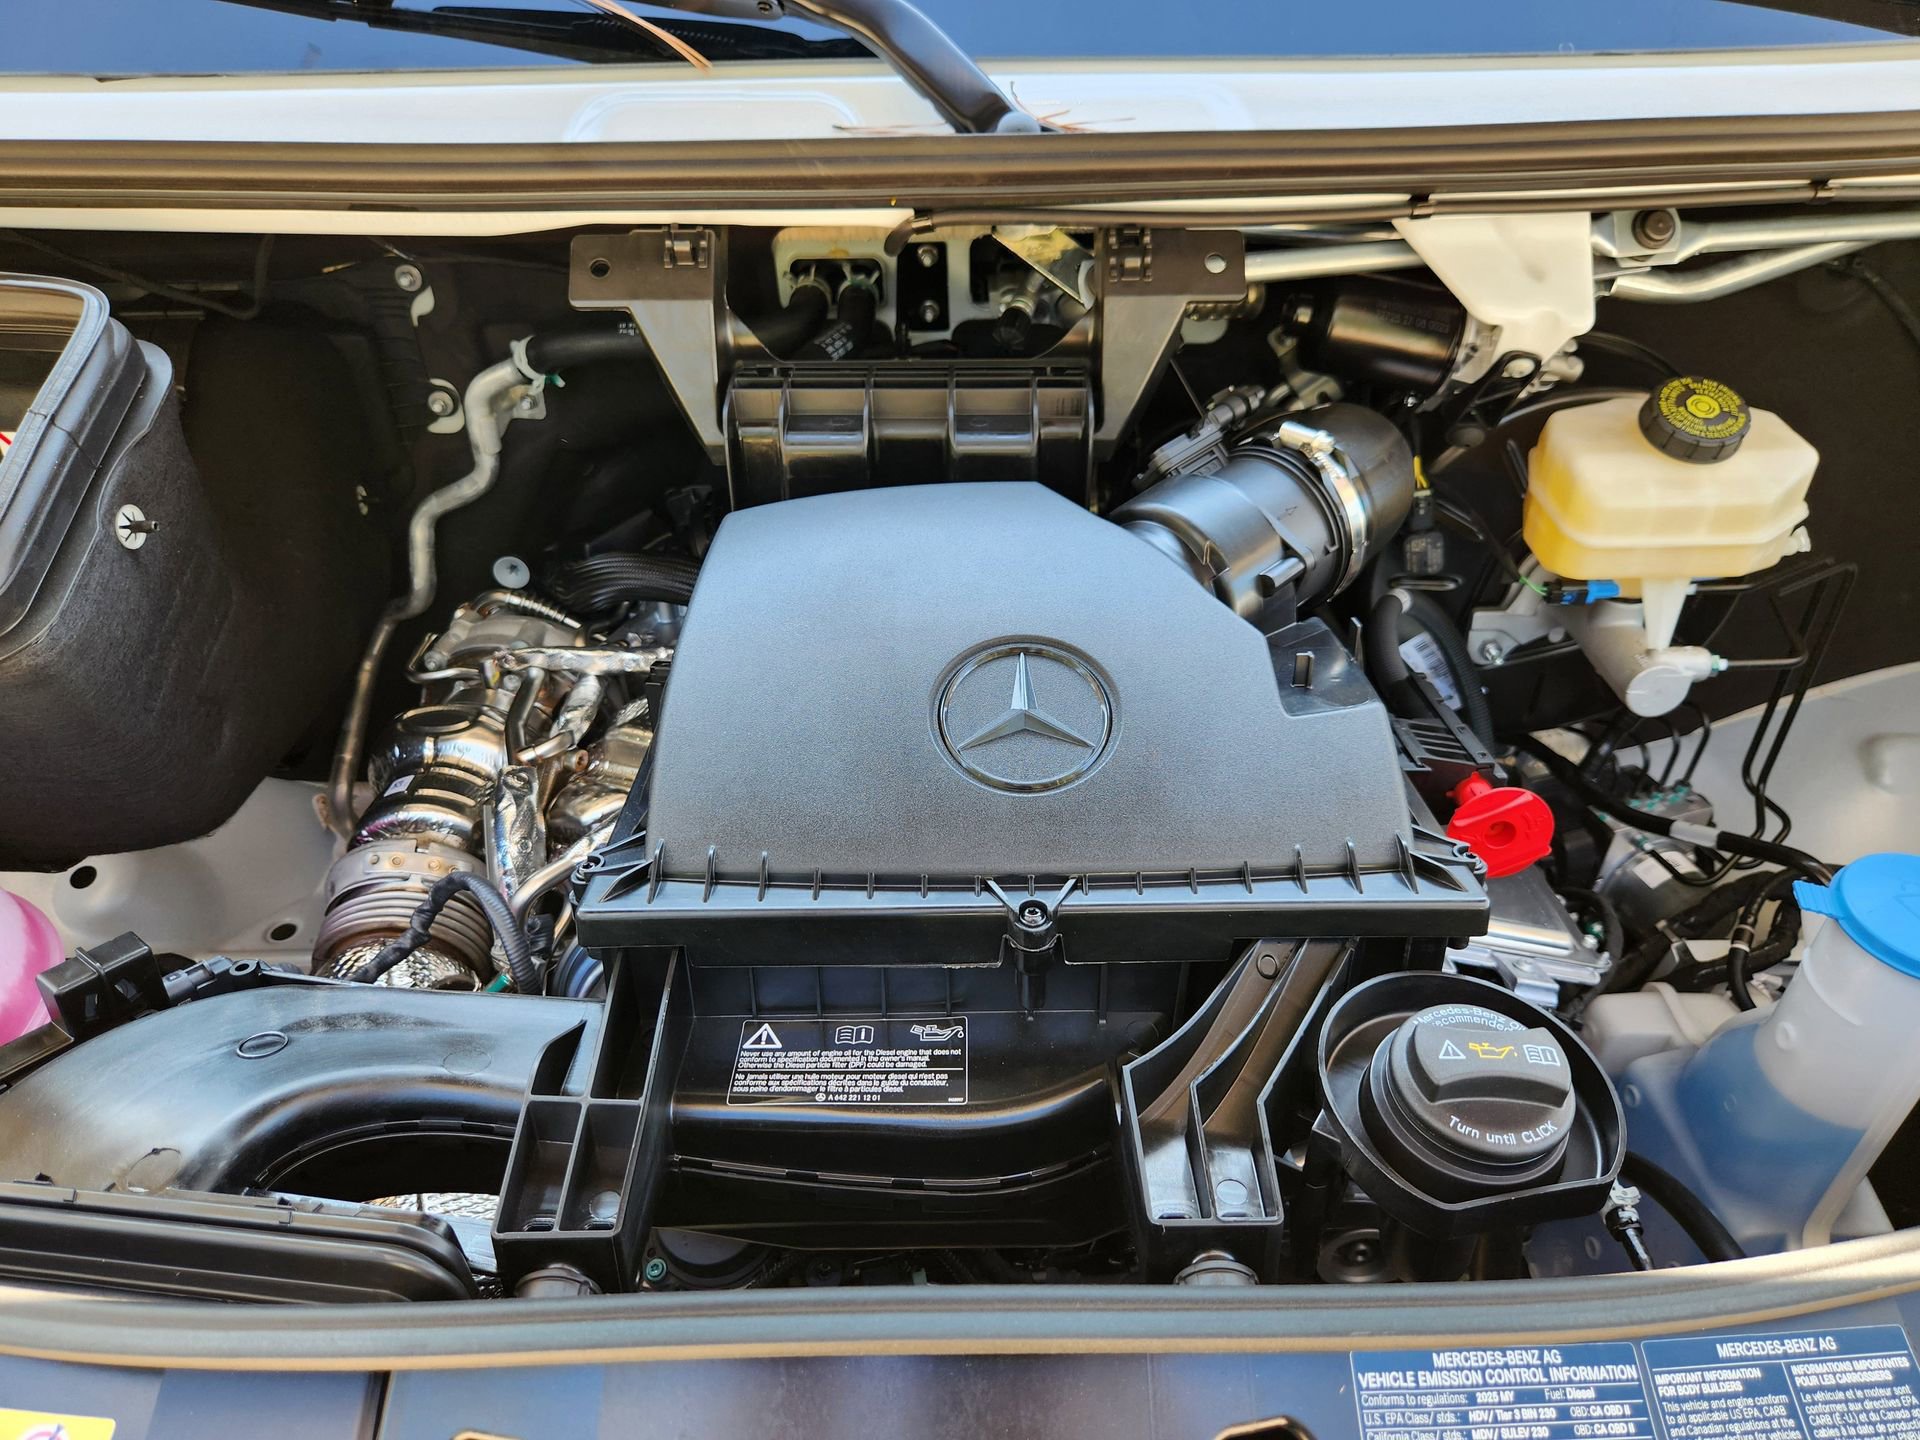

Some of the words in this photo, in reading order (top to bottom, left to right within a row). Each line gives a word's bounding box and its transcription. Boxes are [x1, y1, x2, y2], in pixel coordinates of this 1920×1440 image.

[1449, 1115, 1480, 1140] Turn
[1486, 1132, 1516, 1145] until
[1521, 1120, 1558, 1144] CLICK
[1716, 1338, 1817, 1358] MERCEDES-BENZ
[1818, 1336, 1837, 1351] AG
[1432, 1350, 1542, 1368] MERCEDES-BENZ
[1543, 1349, 1562, 1364] AG
[1357, 1371, 1417, 1389] VEHICLE
[1417, 1369, 1483, 1387] EMISSION
[1485, 1367, 1549, 1385] CONTROL
[1549, 1364, 1638, 1382] INFORMATION
[1654, 1371, 1703, 1385] IMPORTANT
[1703, 1368, 1761, 1381] INFORMATION
[1794, 1374, 1820, 1387] POUR
[1819, 1373, 1836, 1385] LES
[1361, 1393, 1405, 1407] Conforms
[1406, 1393, 1416, 1405] to
[1417, 1391, 1469, 1407] regulations:
[1500, 1390, 1514, 1403] MY
[1544, 1388, 1566, 1400] Fuel:
[1566, 1387, 1595, 1399] Diesel
[1658, 1386, 1677, 1397] FOR
[1677, 1384, 1701, 1396] BODY
[1701, 1381, 1743, 1394] BUILDERS
[1800, 1392, 1811, 1403] Le
[1811, 1389, 1845, 1401] véhicule
[1846, 1389, 1855, 1399] et
[1856, 1388, 1864, 1398] le
[1864, 1386, 1892, 1398] moteur
[1893, 1384, 1912, 1395] sont
[1662, 1401, 1680, 1413] This
[1681, 1400, 1710, 1412] vehicle
[1710, 1398, 1726, 1409] and
[1727, 1396, 1754, 1409] engine
[1755, 1394, 1789, 1405] conform
[1805, 1402, 1848, 1415] conformes
[1848, 1402, 1864, 1411] aux
[1863, 1399, 1902, 1410] directives
[1900, 1395, 1920, 1406] EPA
[1363, 1413, 1383, 1425] U.S.
[1385, 1412, 1404, 1425] EPA
[1513, 1408, 1521, 1420] 3
[1521, 1408, 1538, 1420] BIN
[1538, 1407, 1557, 1419] 230
[1603, 1405, 1623, 1416] OBD
[1623, 1404, 1631, 1415] II
[1666, 1414, 1676, 1425] to
[1677, 1413, 1687, 1424] all
[1688, 1410, 1729, 1425] applicable
[1729, 1408, 1742, 1420] US
[1743, 1408, 1763, 1419] EPA,
[1762, 1405, 1787, 1417] CARB
[1808, 1414, 1833, 1427] CARB
[1858, 1412, 1869, 1423] et
[1868, 1411, 1880, 1421] du
[1879, 1408, 1911, 1420] Canada
[1501, 1427, 1530, 1439] SULEV
[1530, 1426, 1549, 1438] 230
[1607, 1423, 1628, 1434] OBD
[1628, 1423, 1636, 1433] II
[1670, 1426, 1686, 1438] and
[1686, 1424, 1725, 1436] Canadian
[1725, 1420, 1770, 1434] regulations
[1771, 1419, 1781, 1429] at
[1781, 1417, 1796, 1428] the
[1767, 1429, 1802, 1440] vehicles
[1813, 1427, 1840, 1439] cables
[1840, 1425, 1847, 1436] à
[1847, 1425, 1856, 1435] la
[1856, 1424, 1875, 1435] date
[1875, 1422, 1887, 1433] de
